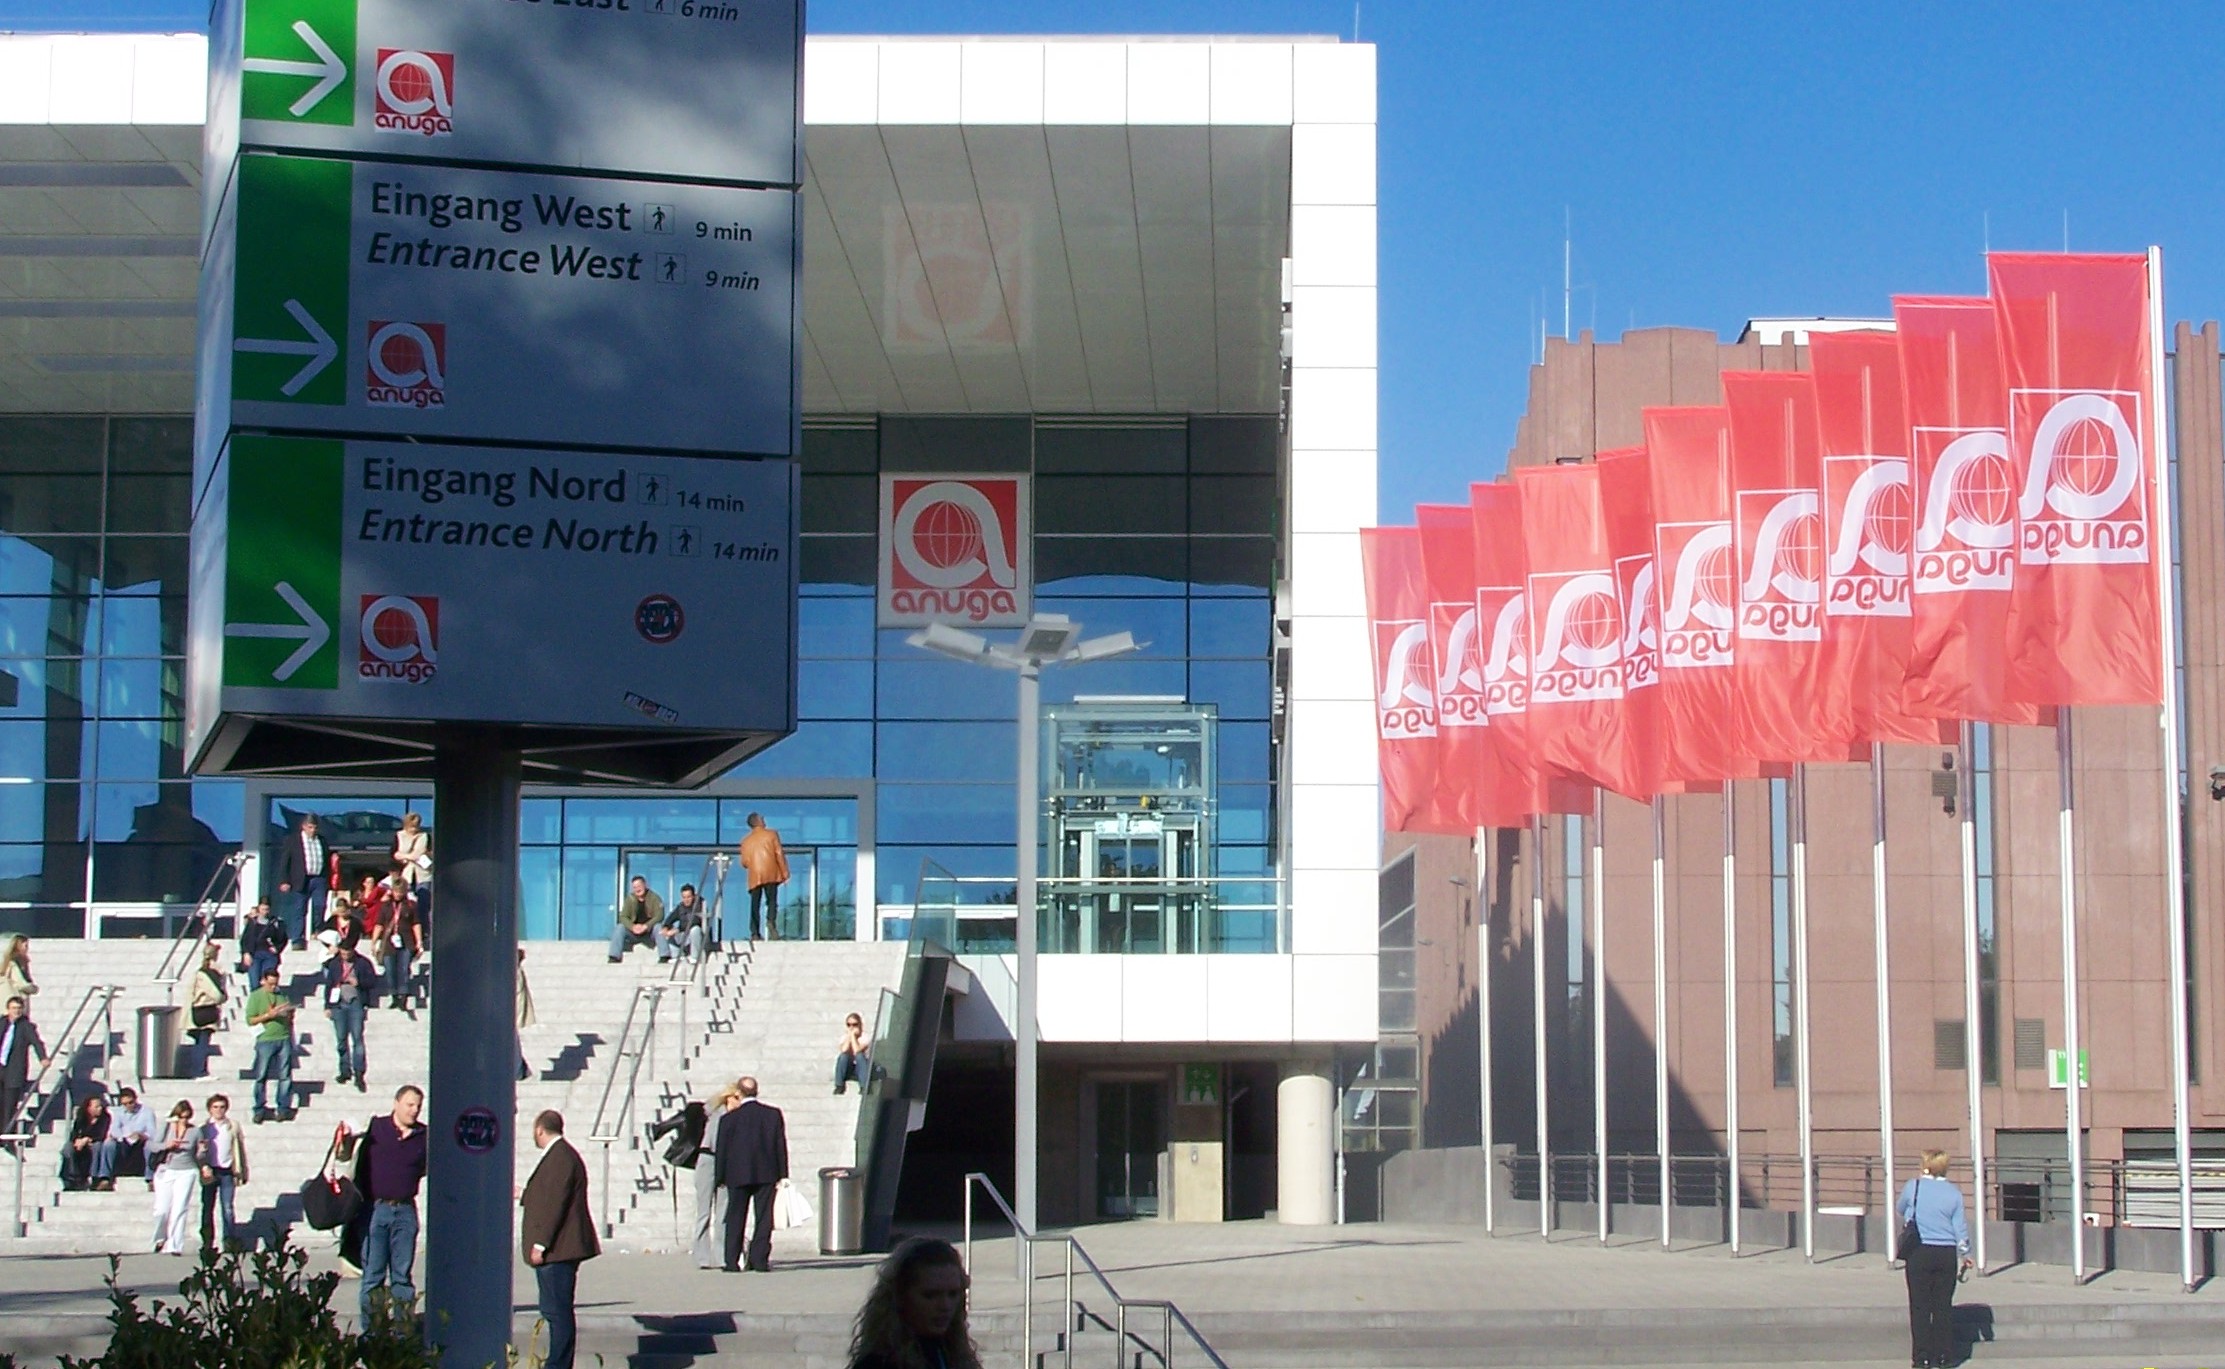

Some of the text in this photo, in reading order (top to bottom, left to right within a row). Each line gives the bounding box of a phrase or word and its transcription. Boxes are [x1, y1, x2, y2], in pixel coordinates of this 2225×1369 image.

[681, 0, 739, 21] 6 min
[375, 114, 453, 136] anuga
[371, 181, 753, 242] Eingang West 9 min
[367, 231, 761, 291] Entrance West 9 min
[367, 388, 445, 408] anuga
[363, 457, 745, 513] Eingang Nord 14 min
[358, 508, 780, 562] Entrance North 14 min
[890, 590, 1017, 621] anuga
